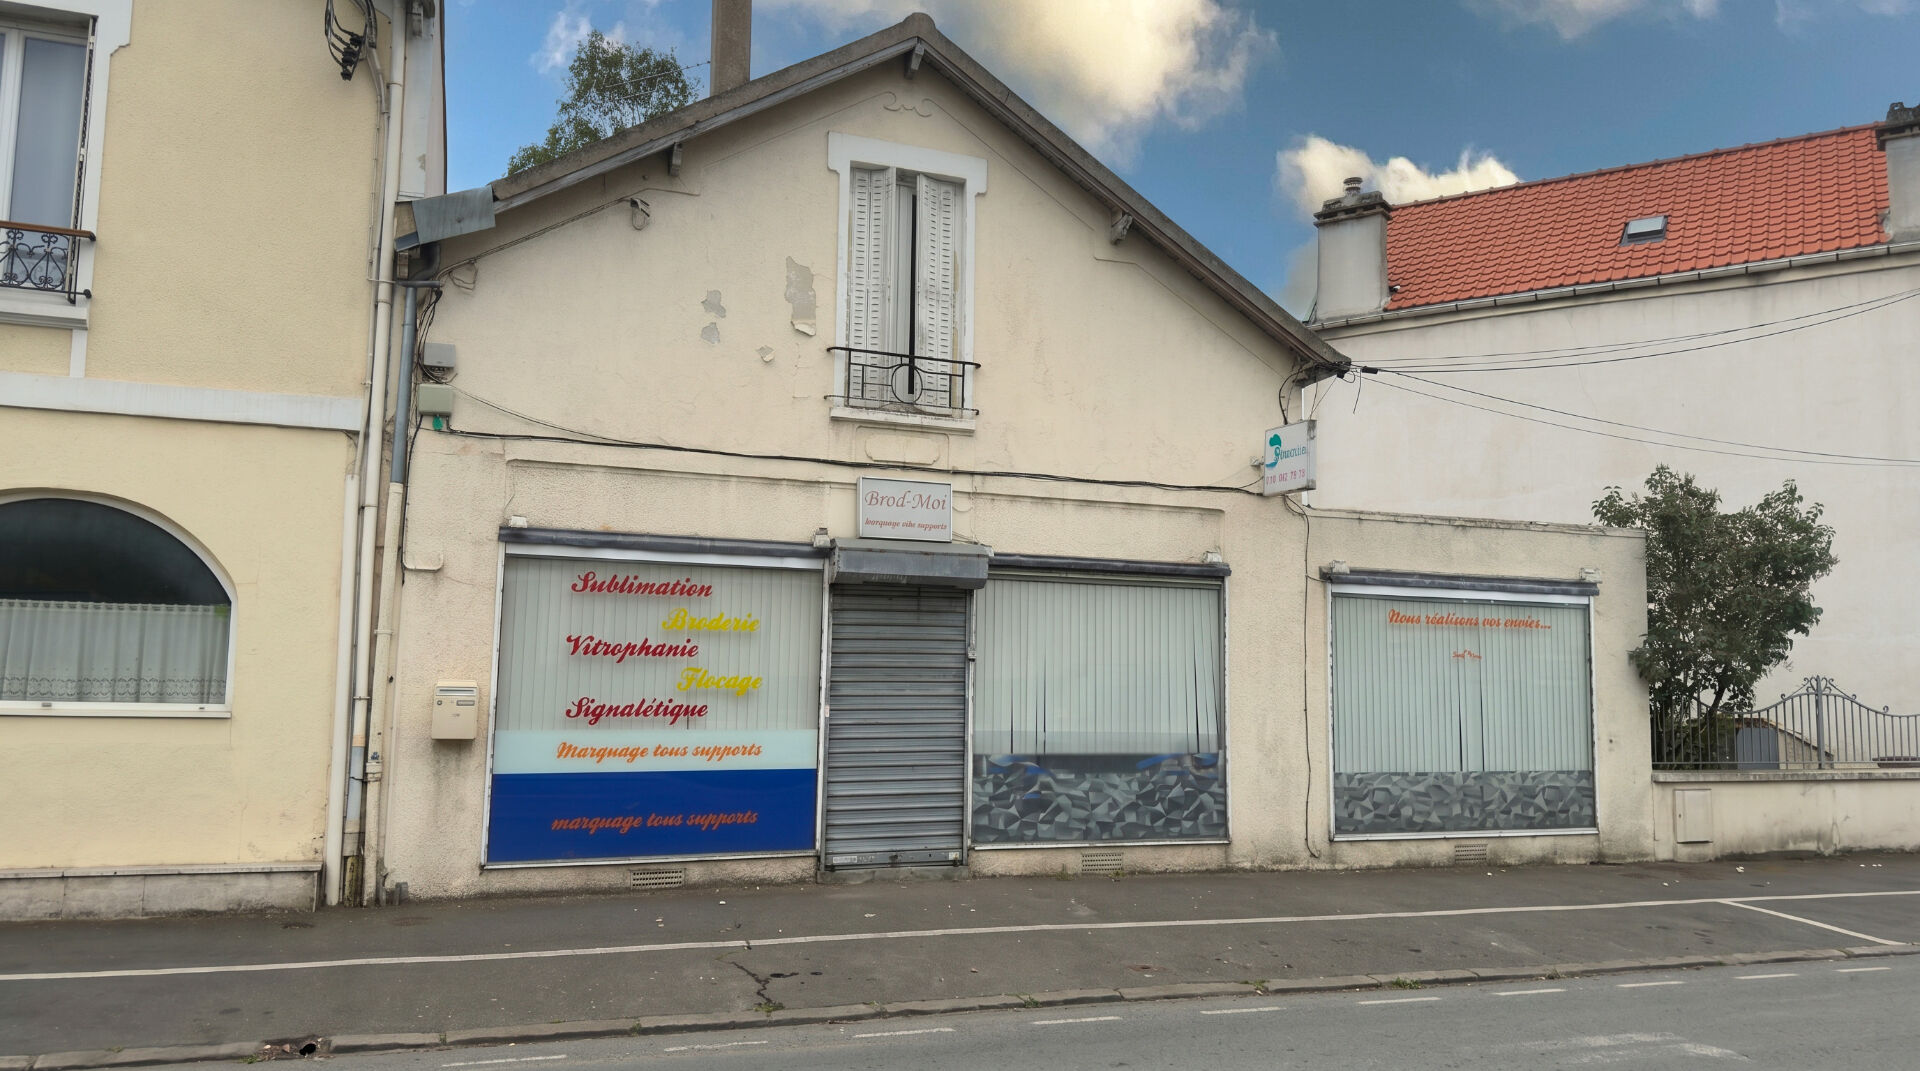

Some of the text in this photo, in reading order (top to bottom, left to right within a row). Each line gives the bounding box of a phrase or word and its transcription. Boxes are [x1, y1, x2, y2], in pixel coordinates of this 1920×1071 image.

[864, 490, 947, 510] Brod-Moi
[571, 571, 713, 598] Sublimation
[661, 607, 761, 633] Broderie
[1388, 608, 1421, 625] Nous
[1425, 612, 1479, 628] réalisons
[1482, 616, 1501, 628] vos
[566, 634, 699, 664] Vitrophanie
[677, 666, 763, 697] Flocage
[565, 696, 709, 726] Signalétique
[556, 741, 762, 764] Marquage tous supports
[551, 809, 759, 835] marquage tous supports
